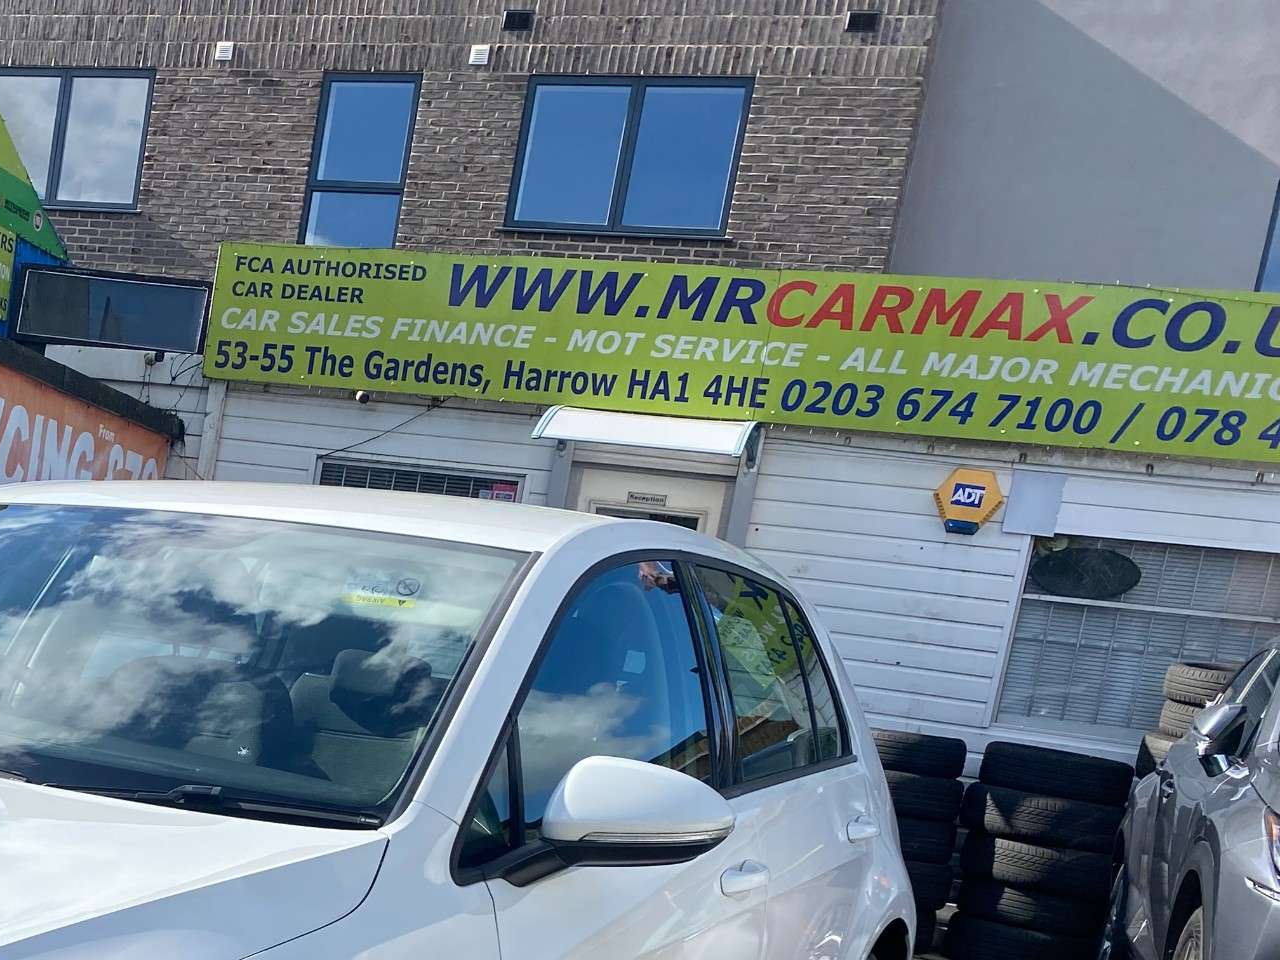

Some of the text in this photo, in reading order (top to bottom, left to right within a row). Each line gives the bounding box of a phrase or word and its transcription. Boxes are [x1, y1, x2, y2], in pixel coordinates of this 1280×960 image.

[235, 255, 427, 282] FCA AUTHORISED
[231, 281, 365, 305] CAR DEALER
[220, 307, 282, 333] CAR
[287, 311, 382, 339] SALES
[390, 317, 536, 350] FINANCE
[567, 327, 650, 354] MOT
[650, 332, 809, 368] SERVICE
[839, 346, 909, 375] ALL
[920, 351, 1058, 384] MAJOR
[214, 339, 294, 374] 53-55
[304, 344, 354, 378] The
[363, 349, 492, 394] Gardens,
[503, 359, 617, 398] Harrow
[626, 369, 690, 403] HA1
[702, 373, 770, 410] 4HE
[781, 377, 885, 419] 0203
[896, 386, 978, 426] 674
[988, 394, 1103, 435] 7100
[1155, 404, 1248, 447] 078
[98, 423, 116, 442] From
[951, 487, 986, 505] ADT
